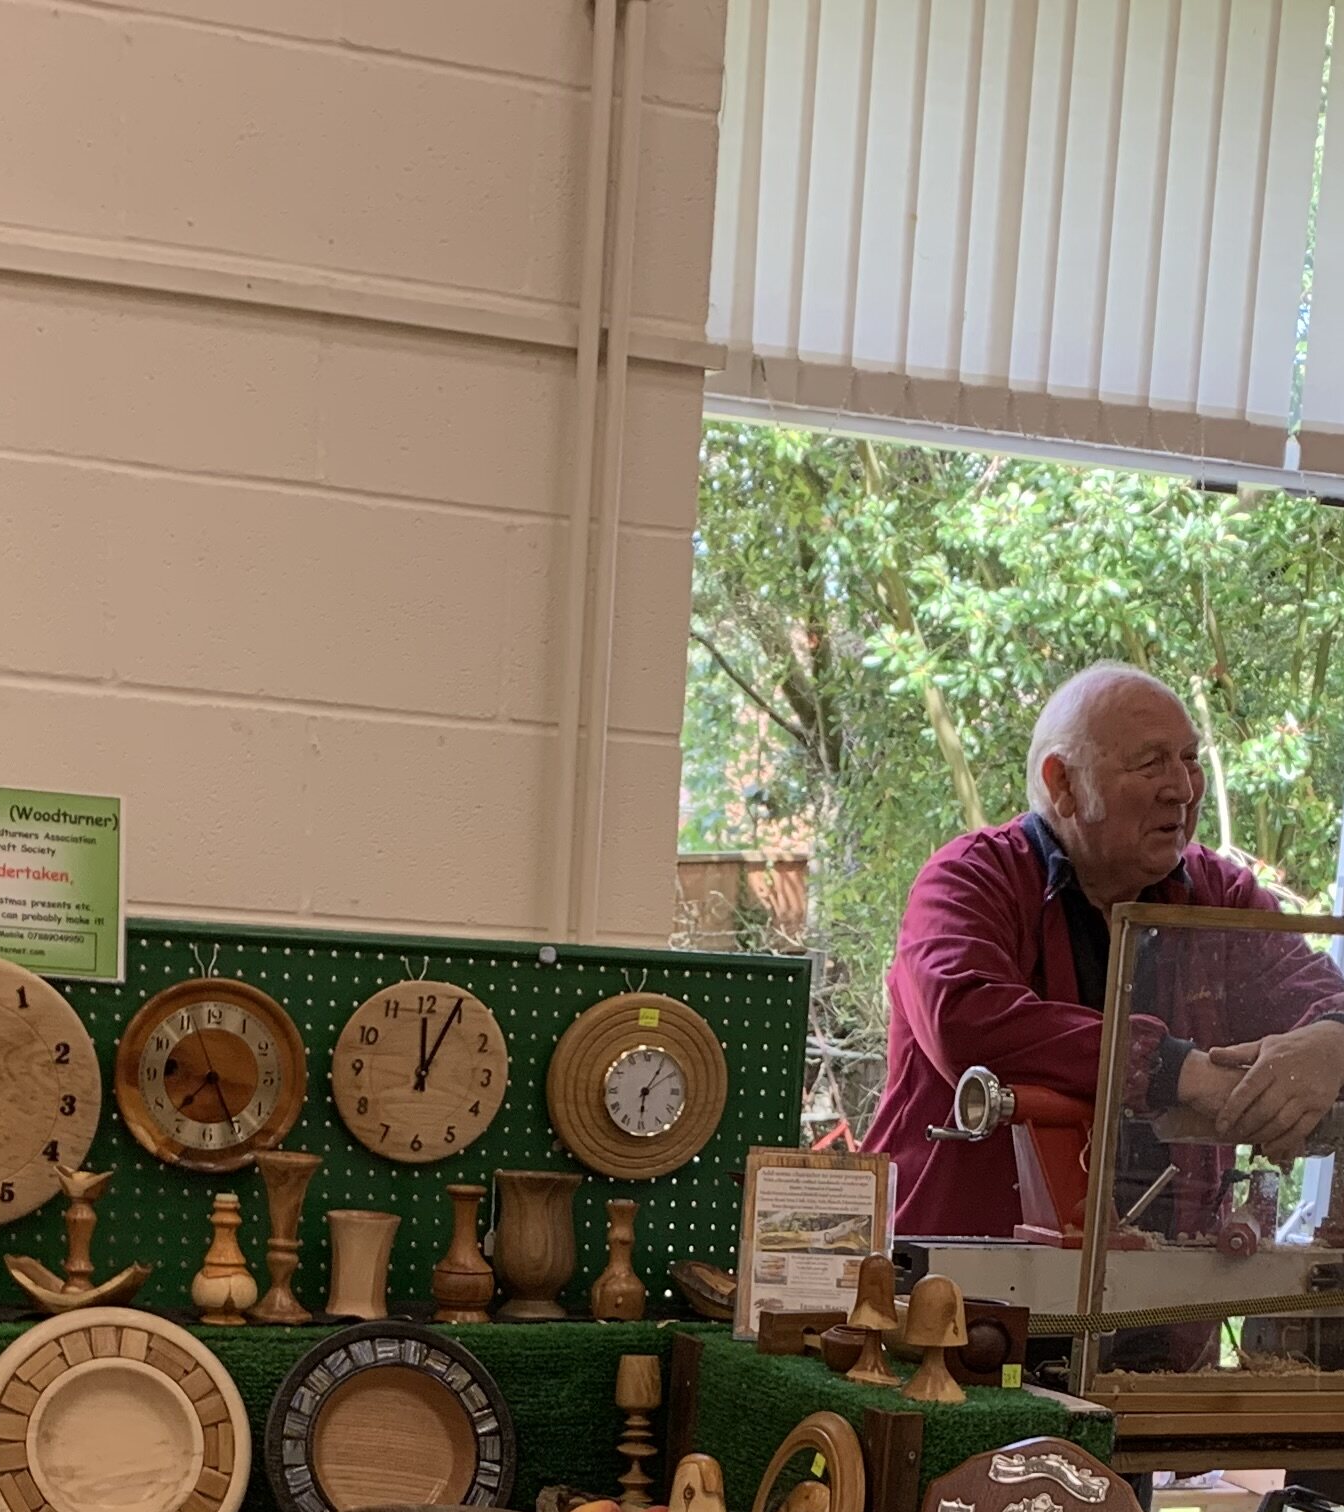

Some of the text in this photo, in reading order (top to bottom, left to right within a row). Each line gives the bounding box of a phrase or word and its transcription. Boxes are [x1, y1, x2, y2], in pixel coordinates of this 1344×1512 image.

[9, 804, 119, 831] (Woodturner)
[44, 832, 97, 844] Association
[21, 844, 56, 857] Society
[31, 899, 72, 910] presents
[1, 911, 18, 919] can
[21, 911, 62, 925] probably
[66, 916, 90, 925] make
[16, 986, 29, 1009] 1
[418, 995, 436, 1014] 12
[208, 1009, 222, 1025] 12
[384, 1000, 399, 1018] 11
[181, 1015, 190, 1031] 11
[241, 1018, 247, 1034] 1
[156, 1036, 169, 1051] 10
[360, 1026, 378, 1045] 10
[478, 1033, 488, 1053] 2
[55, 1042, 70, 1064] 2
[258, 1040, 269, 1056] 2
[352, 1059, 364, 1076] 9
[480, 1069, 492, 1088] 3
[60, 1095, 76, 1116] 3
[357, 1097, 368, 1115] 8
[469, 1100, 480, 1117] 4
[202, 1128, 213, 1142] 6
[379, 1123, 391, 1143] 7
[444, 1126, 455, 1143] 5
[42, 1140, 59, 1162] 4
[410, 1134, 422, 1151] 6
[0, 1182, 15, 1203] 5
